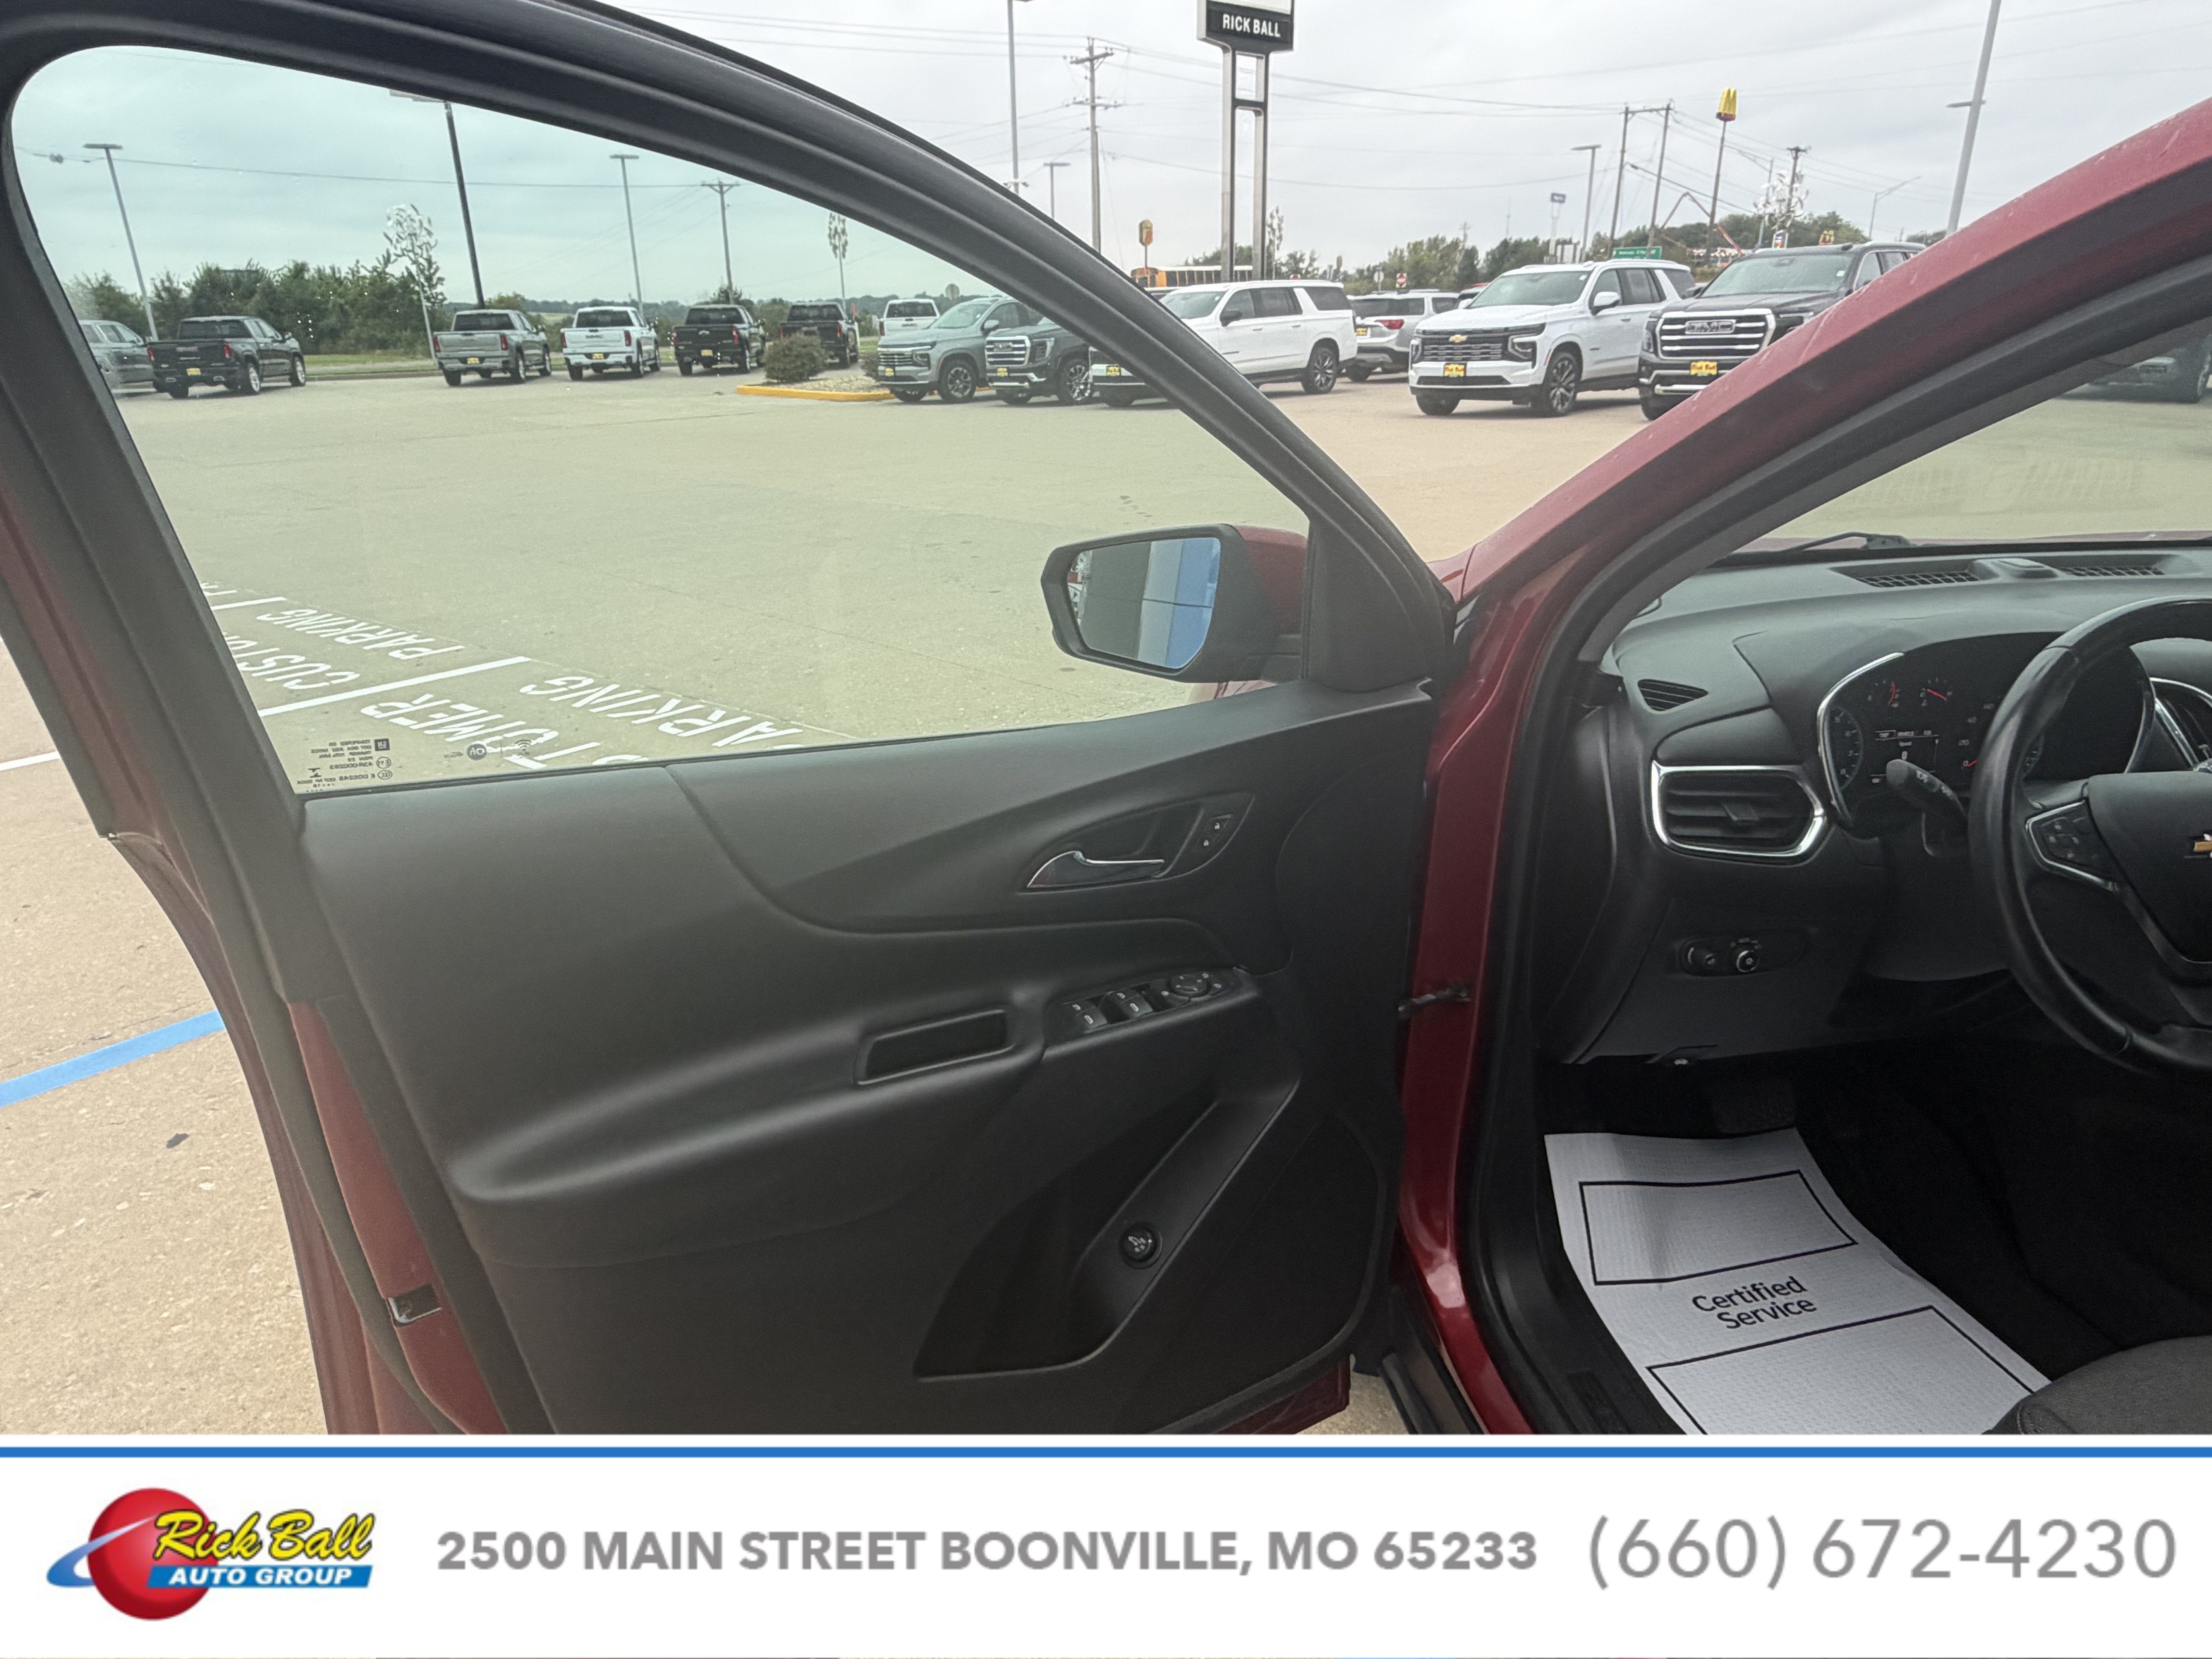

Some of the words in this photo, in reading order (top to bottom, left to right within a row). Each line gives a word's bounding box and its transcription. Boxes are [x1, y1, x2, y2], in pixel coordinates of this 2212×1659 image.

[1223, 14, 1251, 33] RICK
[1253, 19, 1281, 38] BALL
[256, 609, 465, 659] PARKING
[520, 676, 804, 749] ARKING
[1692, 1276, 1808, 1312] Certified
[1717, 1299, 1817, 1329] Service
